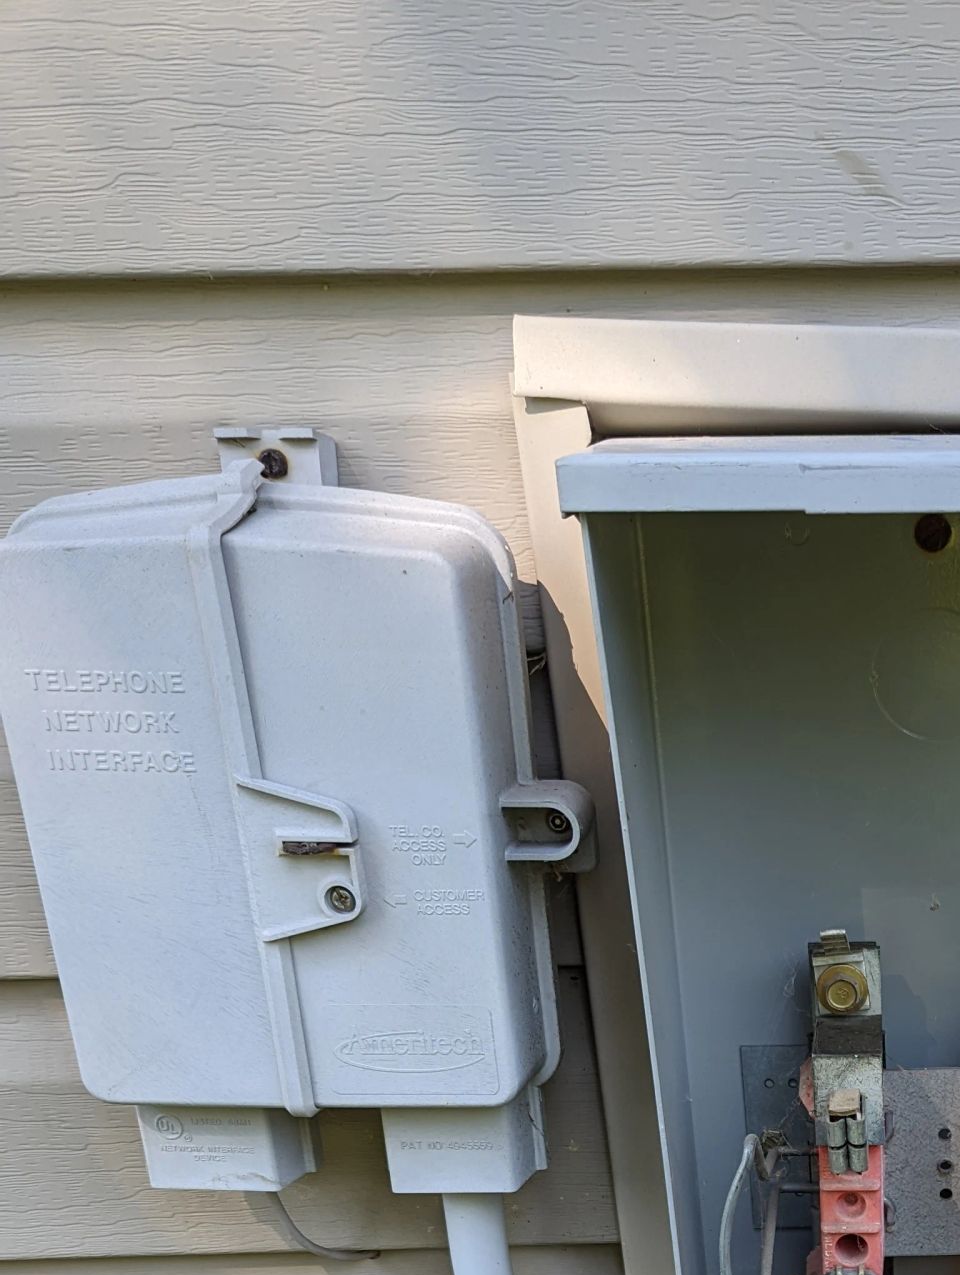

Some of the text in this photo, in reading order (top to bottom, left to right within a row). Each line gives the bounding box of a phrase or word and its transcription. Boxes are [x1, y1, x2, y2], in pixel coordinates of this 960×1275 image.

[23, 668, 187, 694] TELEPHONE
[42, 709, 181, 734] NETWORK
[46, 749, 198, 774] INTERFACE
[391, 839, 447, 853] ACCESS
[411, 852, 447, 867] ONLY
[413, 888, 487, 902] CUSTOMER
[416, 903, 471, 916] ACCESS
[340, 1028, 486, 1056] Ameritech
[160, 1144, 255, 1155] NETWORK INTERFACE
[400, 1140, 423, 1151] PAT
[193, 1154, 226, 1163] DEVICE
